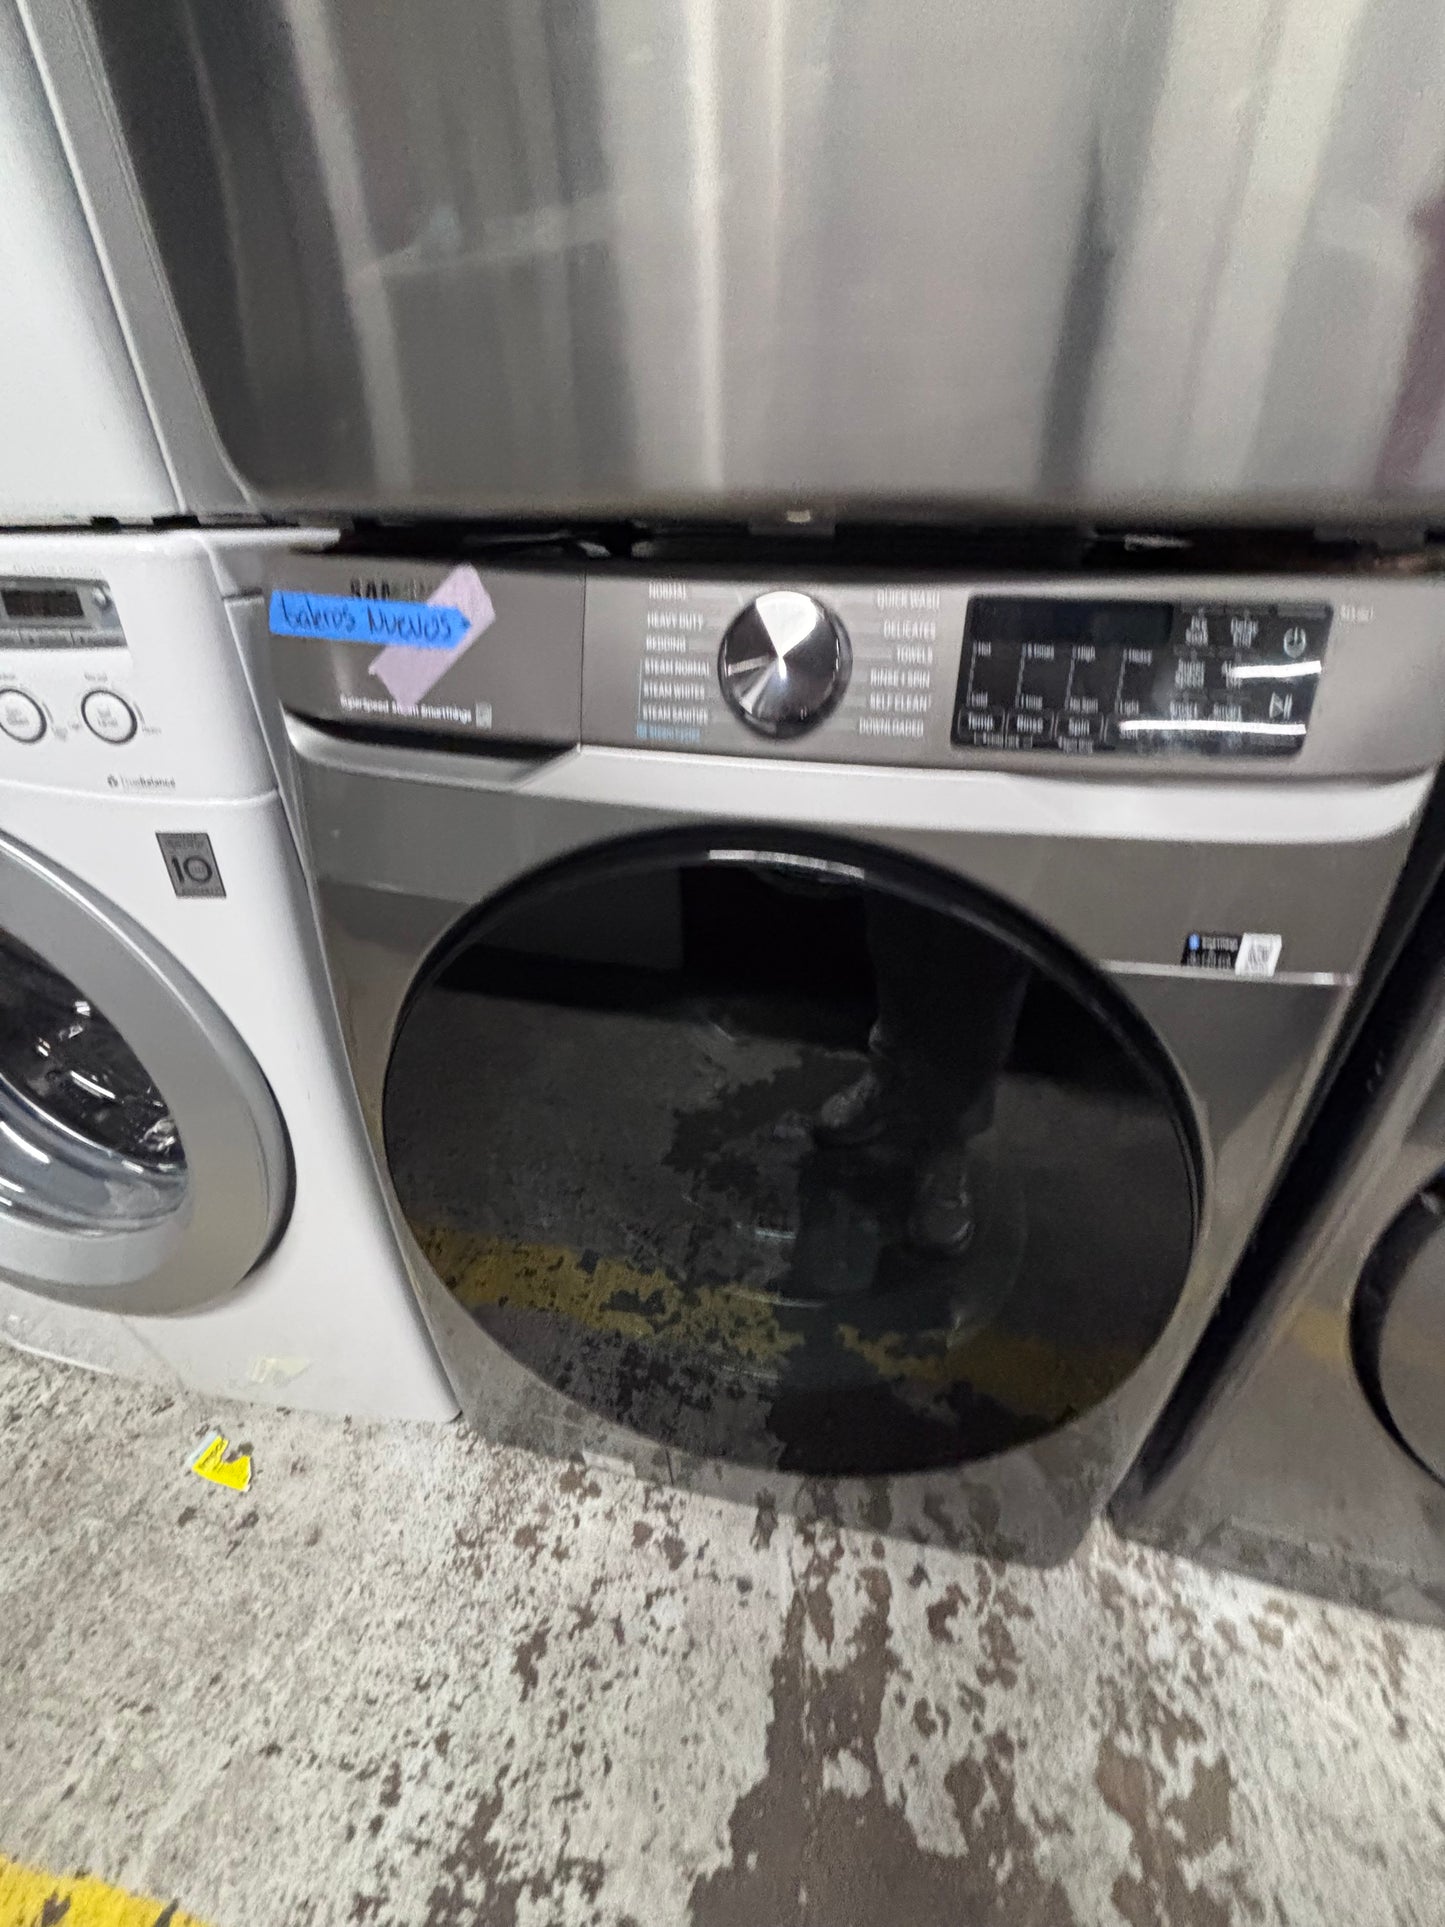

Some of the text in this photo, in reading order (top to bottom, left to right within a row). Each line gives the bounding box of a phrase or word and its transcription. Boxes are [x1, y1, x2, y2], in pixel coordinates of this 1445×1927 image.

[647, 612, 704, 631] HEAVY DUTY
[883, 619, 936, 641] DELICATES
[644, 657, 673, 675] STEAM
[643, 681, 672, 699] STEAM
[642, 704, 671, 721] STEAM
